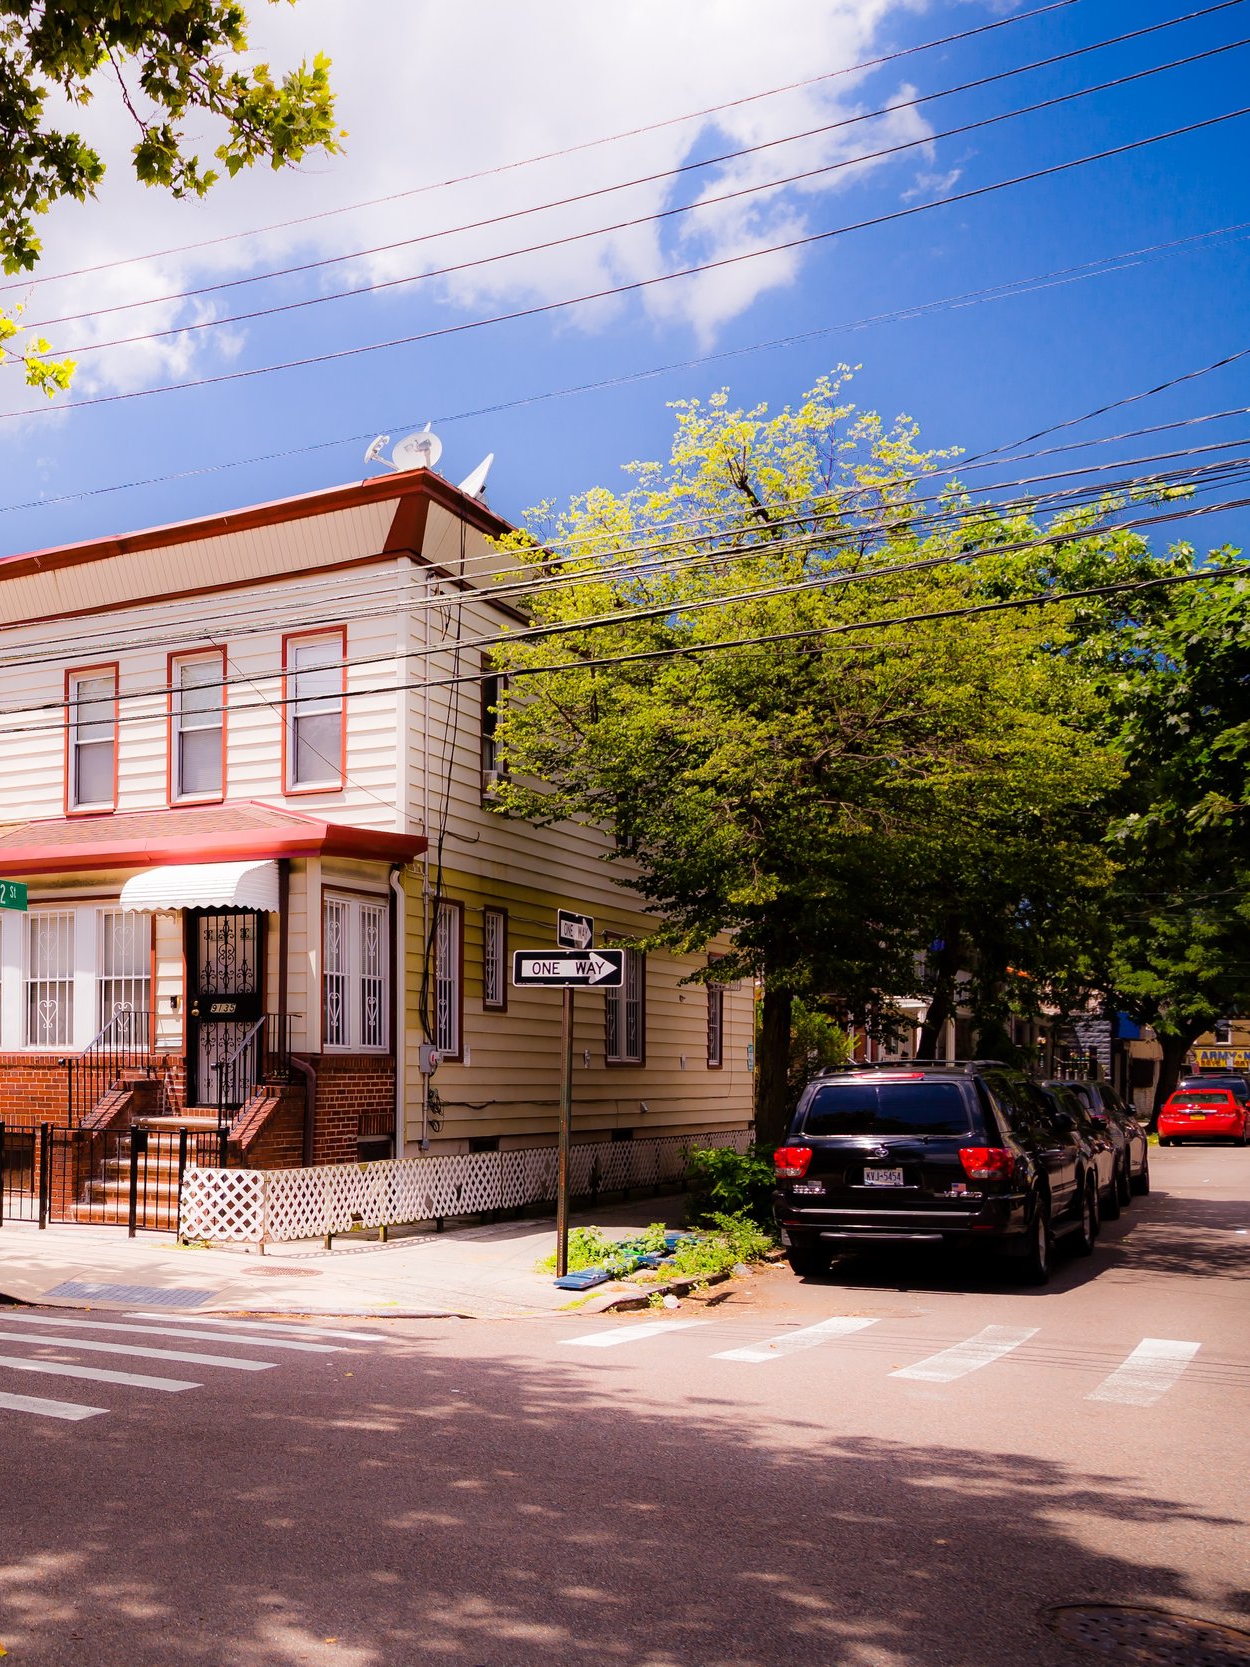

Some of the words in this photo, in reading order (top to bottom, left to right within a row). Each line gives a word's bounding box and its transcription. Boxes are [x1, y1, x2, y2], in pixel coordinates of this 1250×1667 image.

[10, 885, 16, 898] St
[563, 922, 574, 937] ONE
[532, 961, 560, 975] ONE
[575, 961, 605, 975] WAY
[211, 1004, 236, 1013] 9135
[865, 1171, 901, 1181] KVJ-5454
